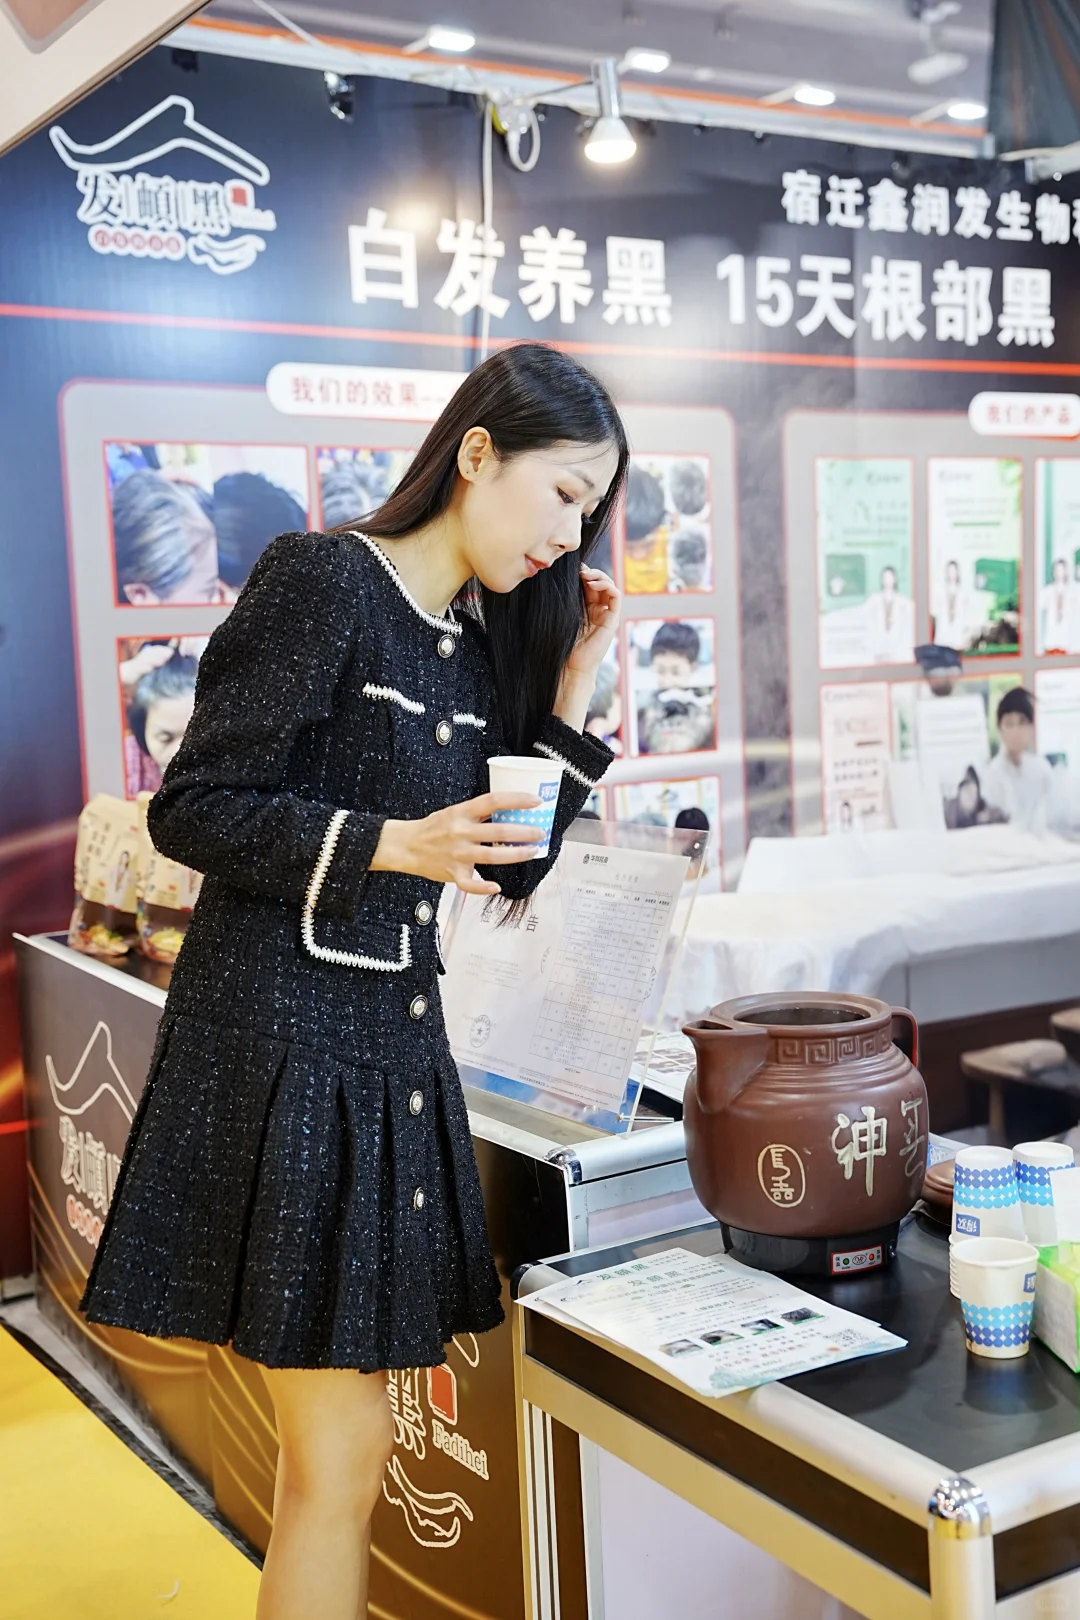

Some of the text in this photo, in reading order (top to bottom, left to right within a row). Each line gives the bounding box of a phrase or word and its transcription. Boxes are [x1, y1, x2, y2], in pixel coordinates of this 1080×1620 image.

[347, 207, 672, 328] 白发养黑
[716, 253, 1055, 348] 15天根部黑
[432, 1420, 488, 1479] Fadihei
